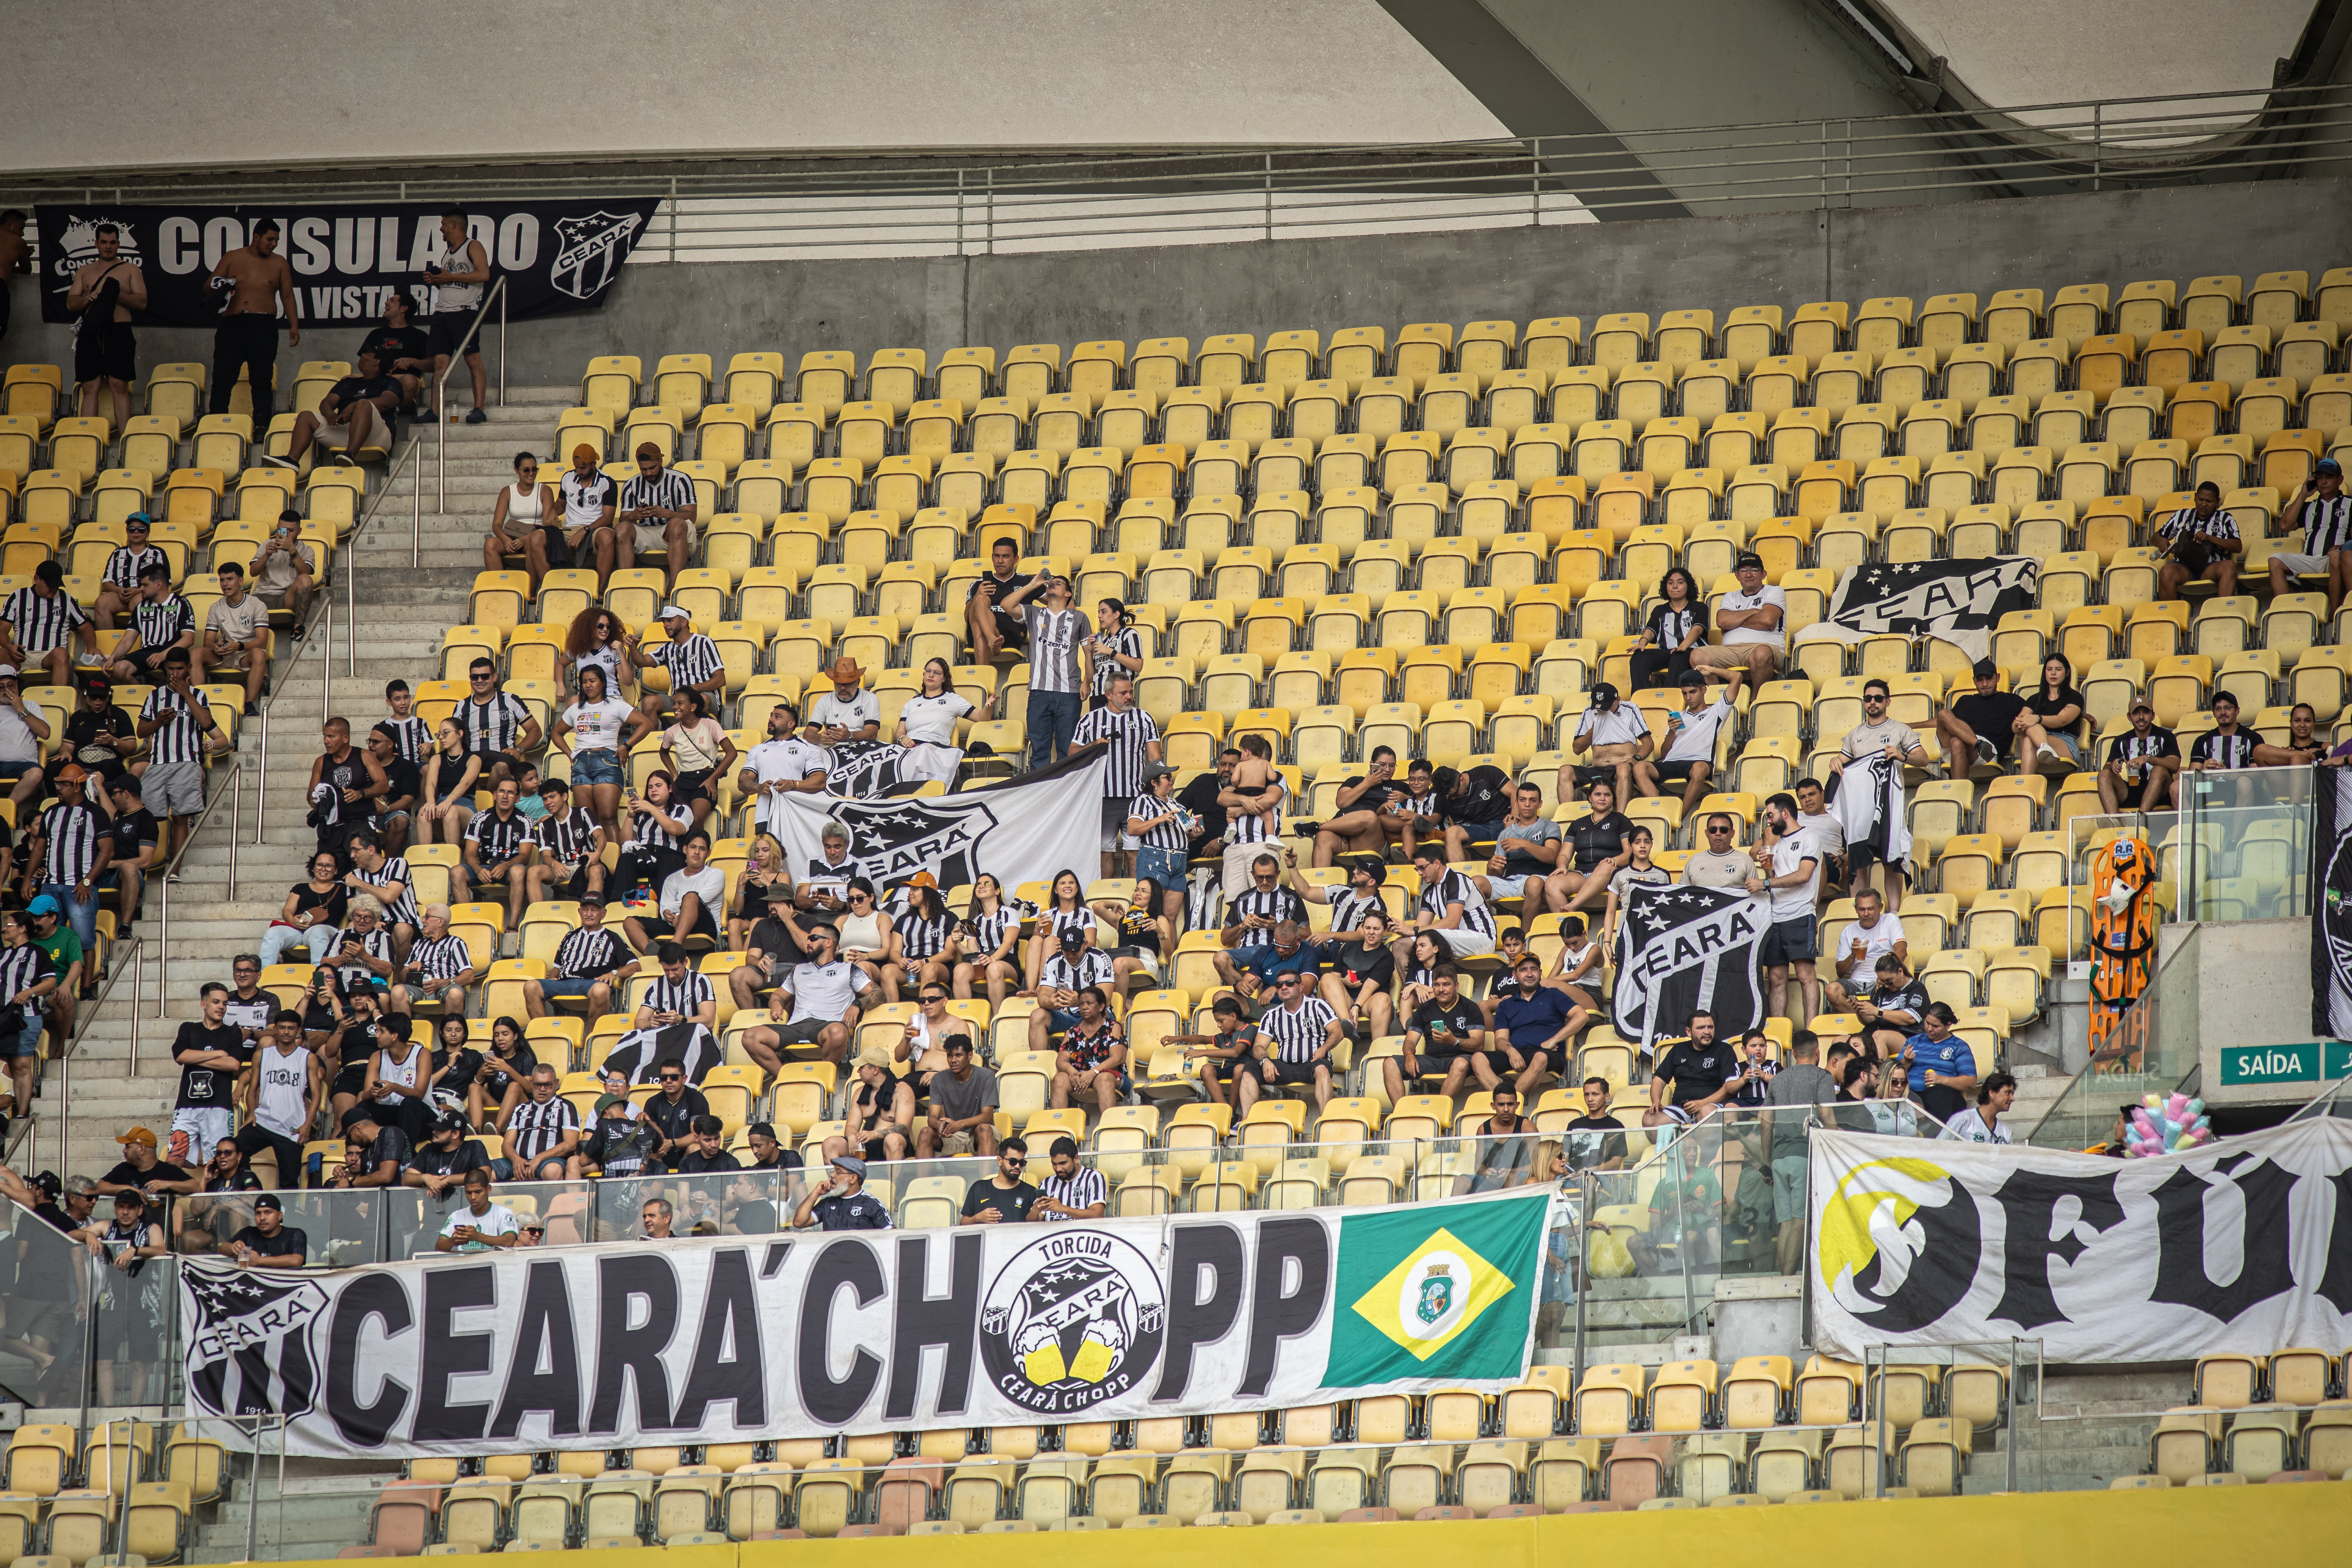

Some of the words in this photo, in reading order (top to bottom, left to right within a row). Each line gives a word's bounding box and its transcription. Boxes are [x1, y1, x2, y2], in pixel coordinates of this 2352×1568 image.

[159, 214, 539, 275] COSULAO
[477, 728, 492, 738] 10
[833, 746, 898, 779] CEARÁ
[337, 774, 349, 783] 82
[867, 822, 971, 879] EARÁ
[2239, 1051, 2302, 1076] SAÍDA
[1039, 1236, 1112, 1261] TORCIDA
[1045, 1273, 1125, 1328] EARÁ
[1140, 1307, 1163, 1322] CEARÁ
[199, 1291, 312, 1358] CEARÁ
[984, 1311, 1008, 1324] CEARÁ
[1001, 1374, 1058, 1410] CEARÁ
[1064, 1373, 1129, 1409] CHOPP
